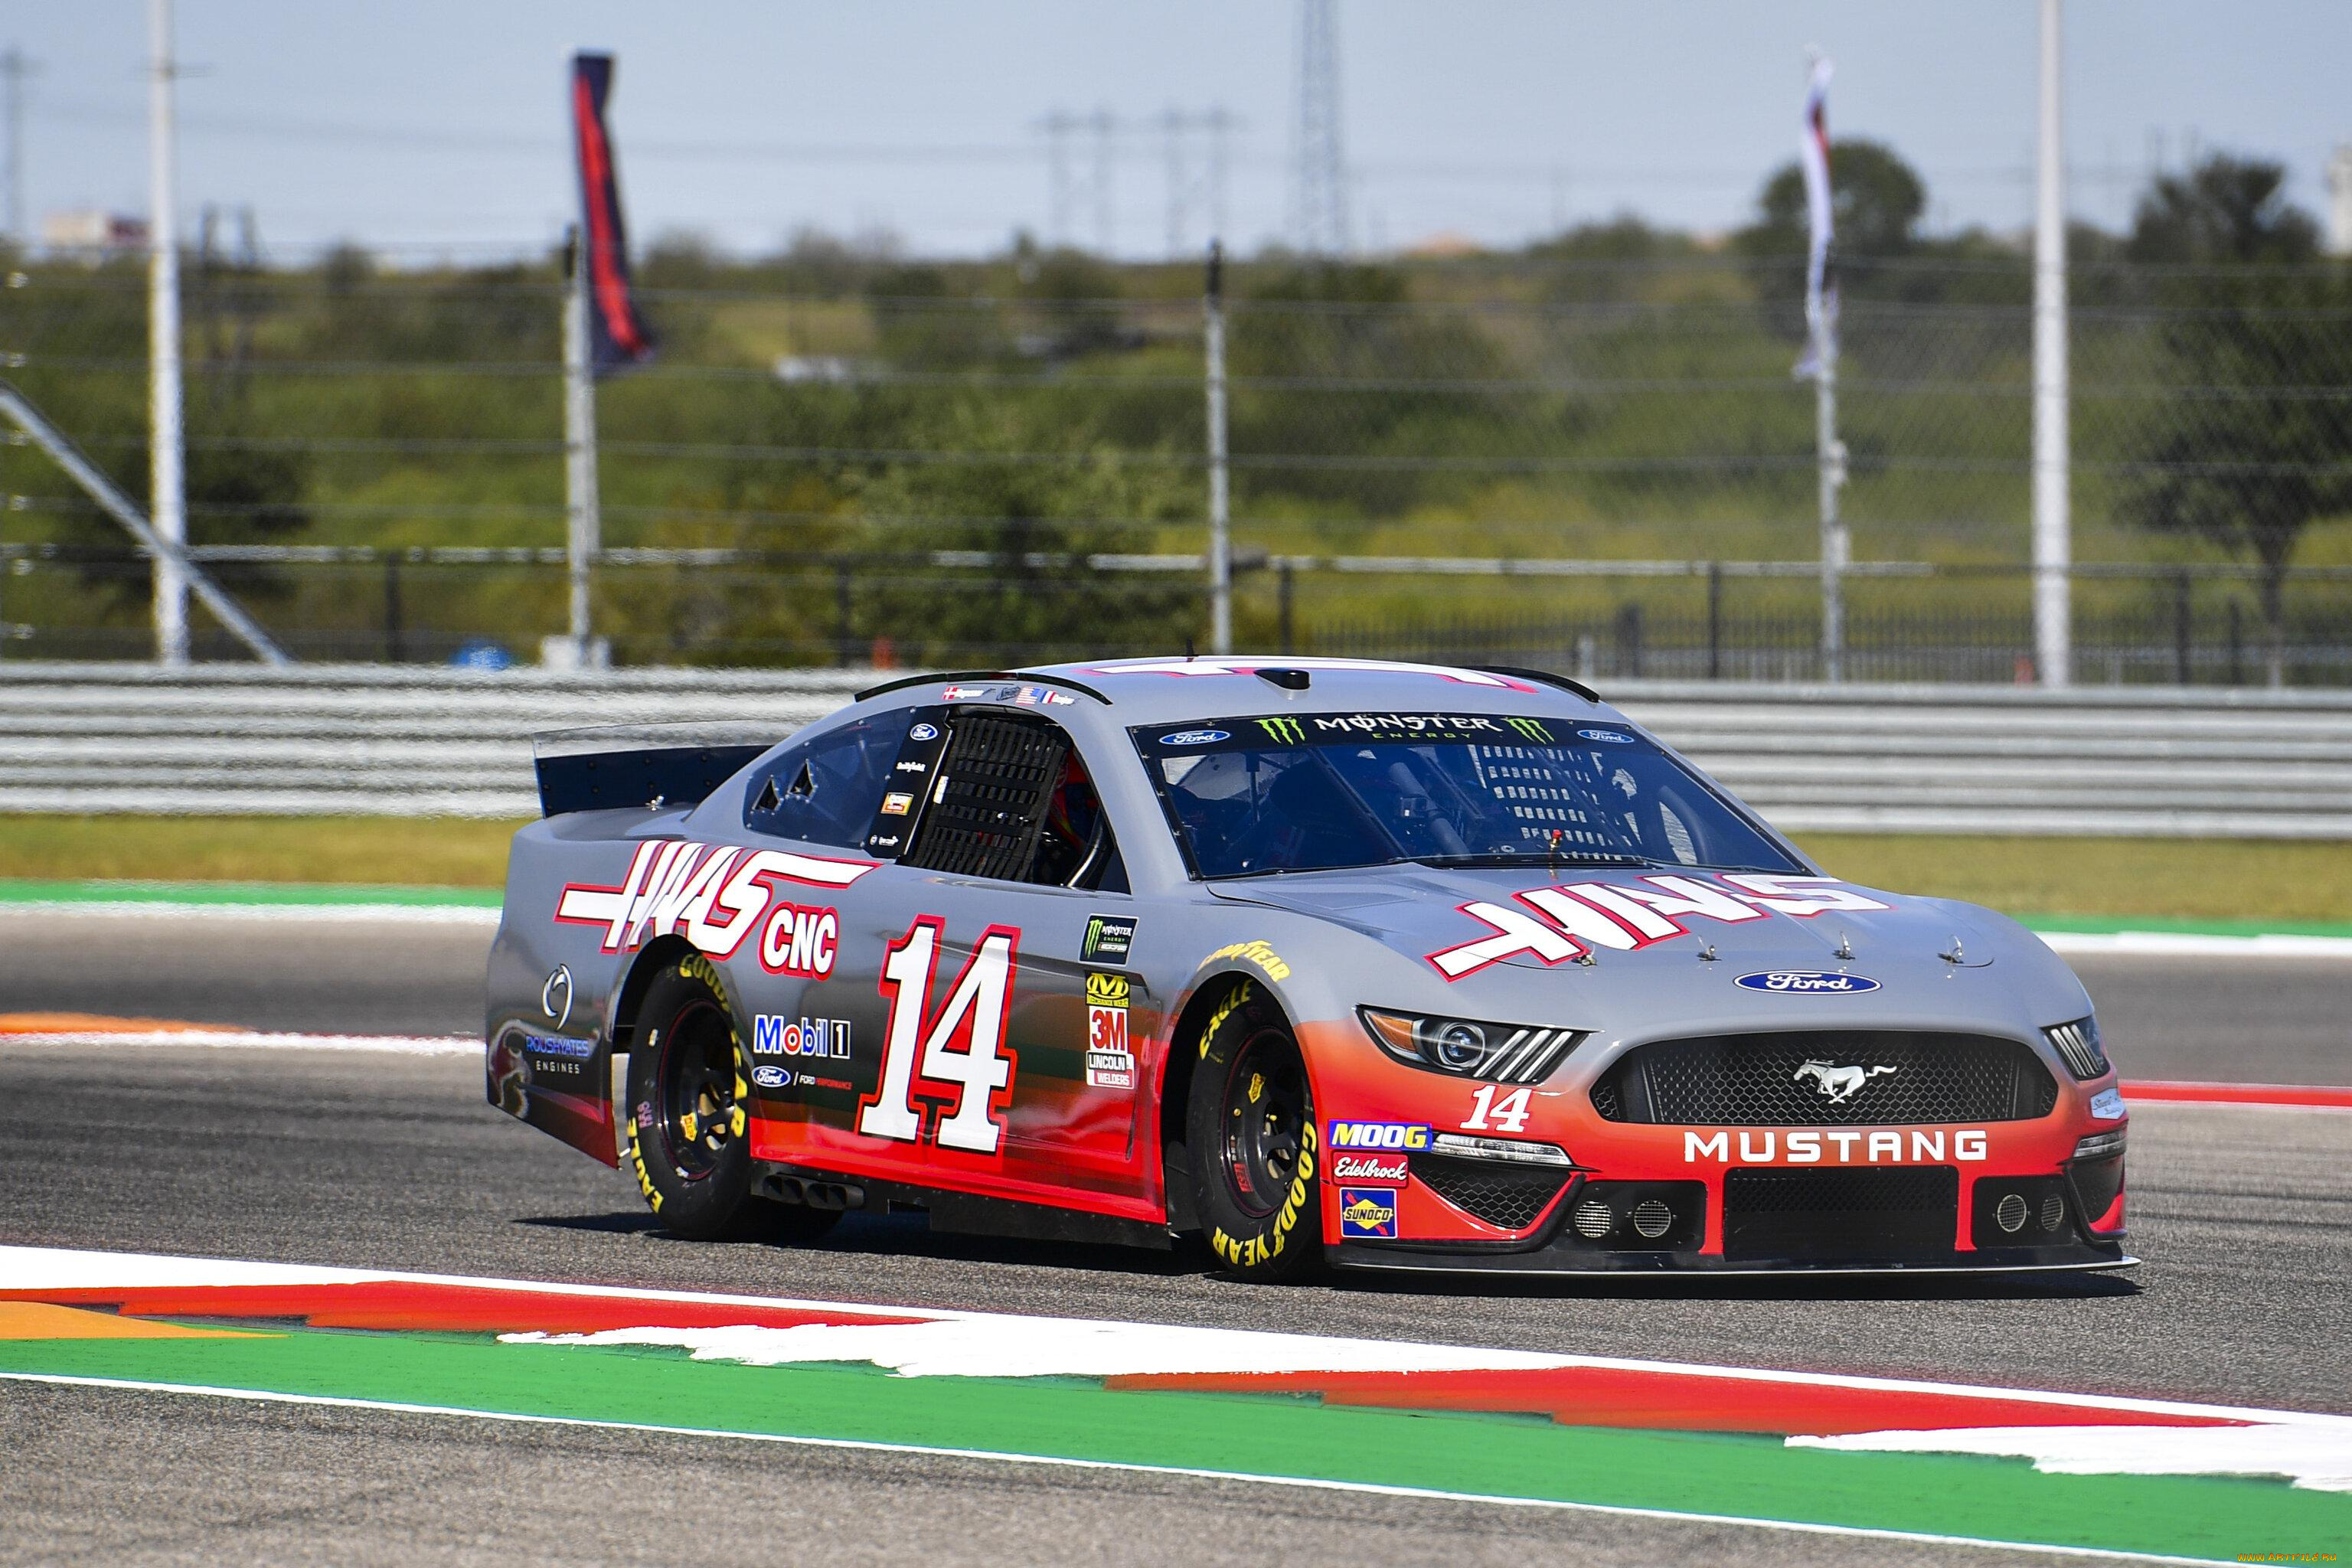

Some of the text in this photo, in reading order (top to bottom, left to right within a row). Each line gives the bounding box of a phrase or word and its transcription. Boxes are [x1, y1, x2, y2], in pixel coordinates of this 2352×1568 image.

[1313, 714, 1504, 733] MONSTER
[1586, 729, 1625, 742] Ford
[1173, 732, 1217, 743] Ford
[1372, 732, 1472, 740] ENERGY
[556, 840, 878, 956] HAAS
[1426, 874, 1893, 981] HAAS
[763, 906, 837, 975] CNC
[1766, 972, 1854, 990] Ford
[1092, 1010, 1125, 1051] 3M
[1199, 978, 1252, 1060] EAGLE
[754, 1014, 828, 1057] Mobil
[858, 922, 1012, 1155] 14
[536, 1060, 581, 1075] ENGINES
[1089, 1054, 1125, 1071] LINCOLN
[756, 1068, 782, 1084] Ford
[1097, 1072, 1130, 1086] WELDERS
[1459, 1084, 1534, 1133] 14
[1331, 1123, 1428, 1148] MOOG
[1684, 1130, 1988, 1163] MUSTANG
[1334, 1157, 1407, 1181] Edelbrock
[1345, 1208, 1392, 1221] SUNOCO
